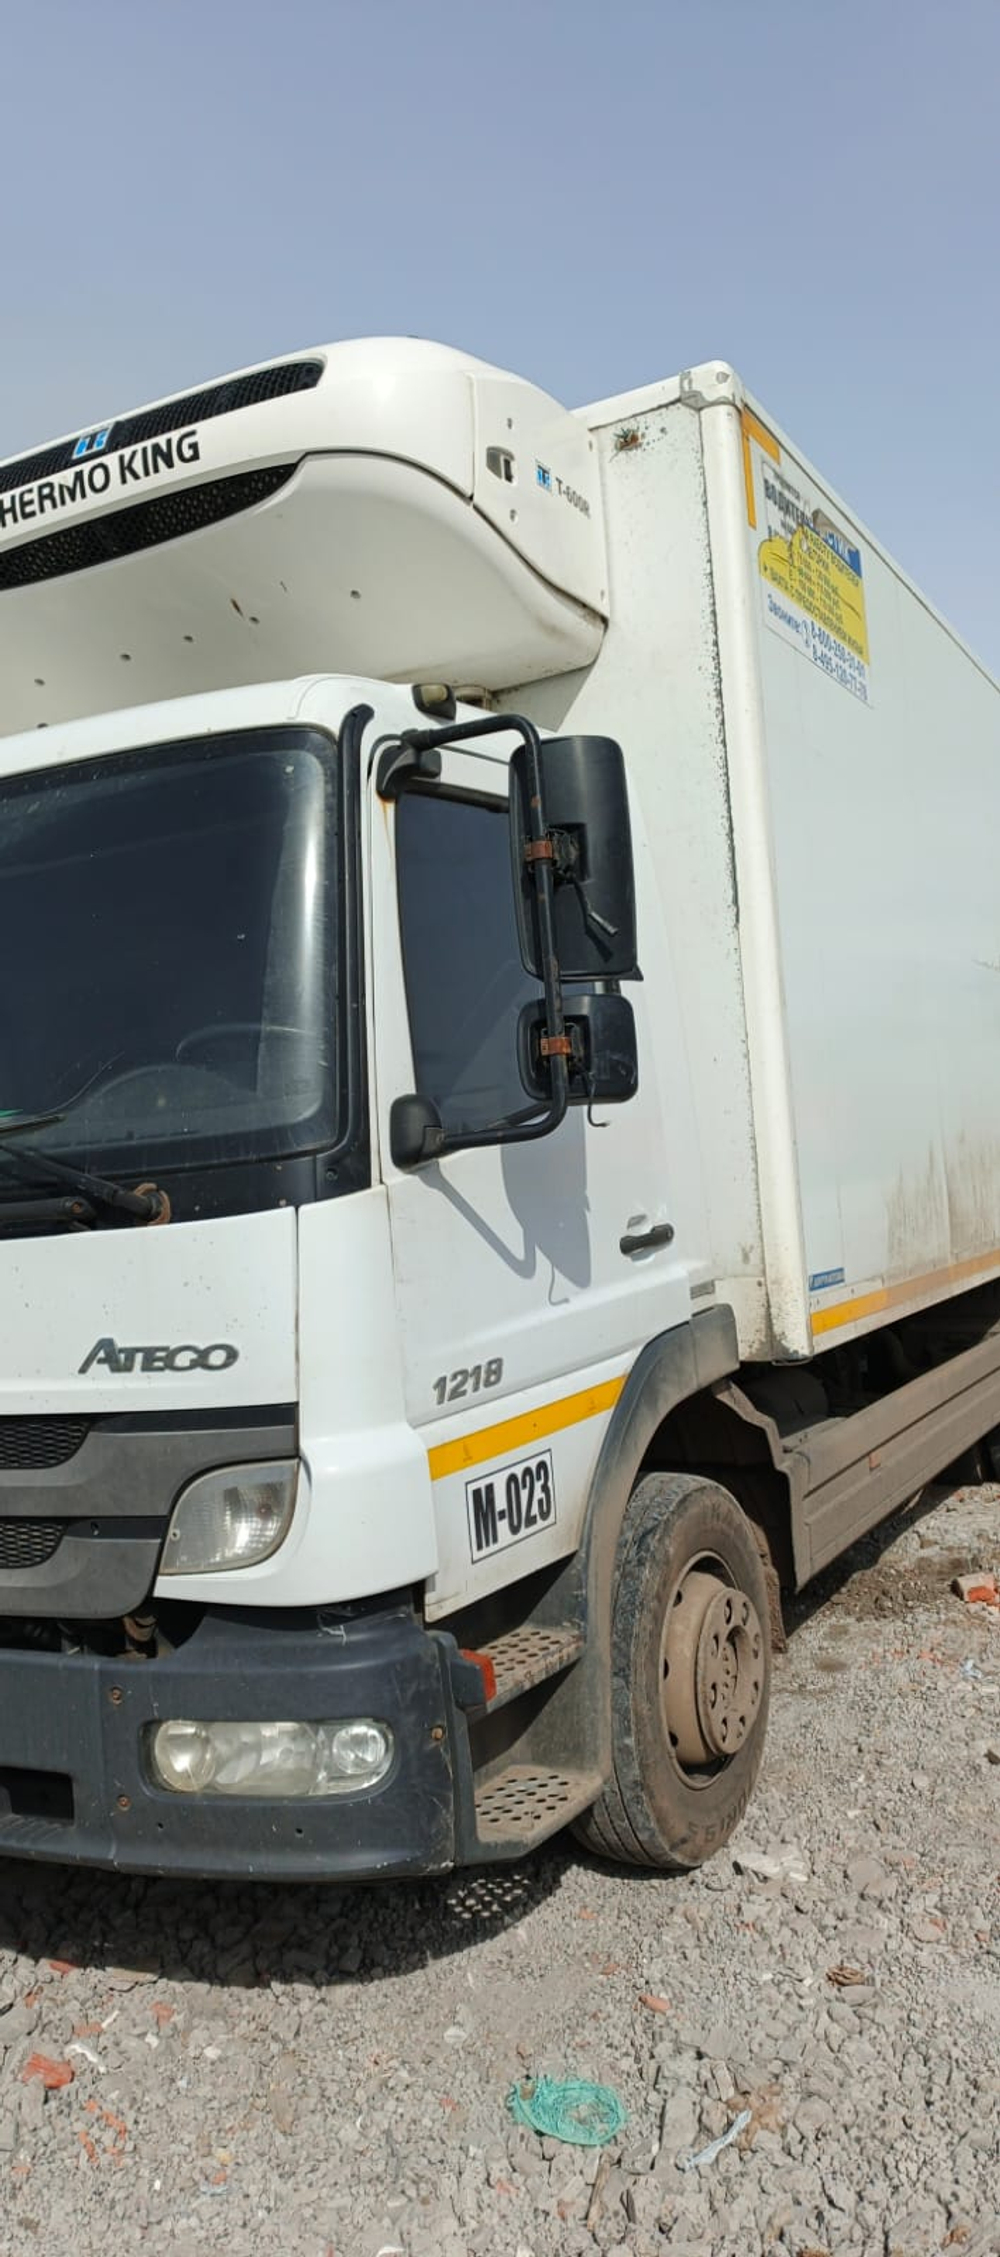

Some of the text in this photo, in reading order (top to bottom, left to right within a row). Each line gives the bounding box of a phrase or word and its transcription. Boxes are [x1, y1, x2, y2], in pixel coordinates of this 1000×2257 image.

[119, 430, 201, 486] KING
[78, 1338, 239, 1375] ATEGO
[432, 1357, 503, 1405] 1218
[472, 1459, 551, 1551] M-023
